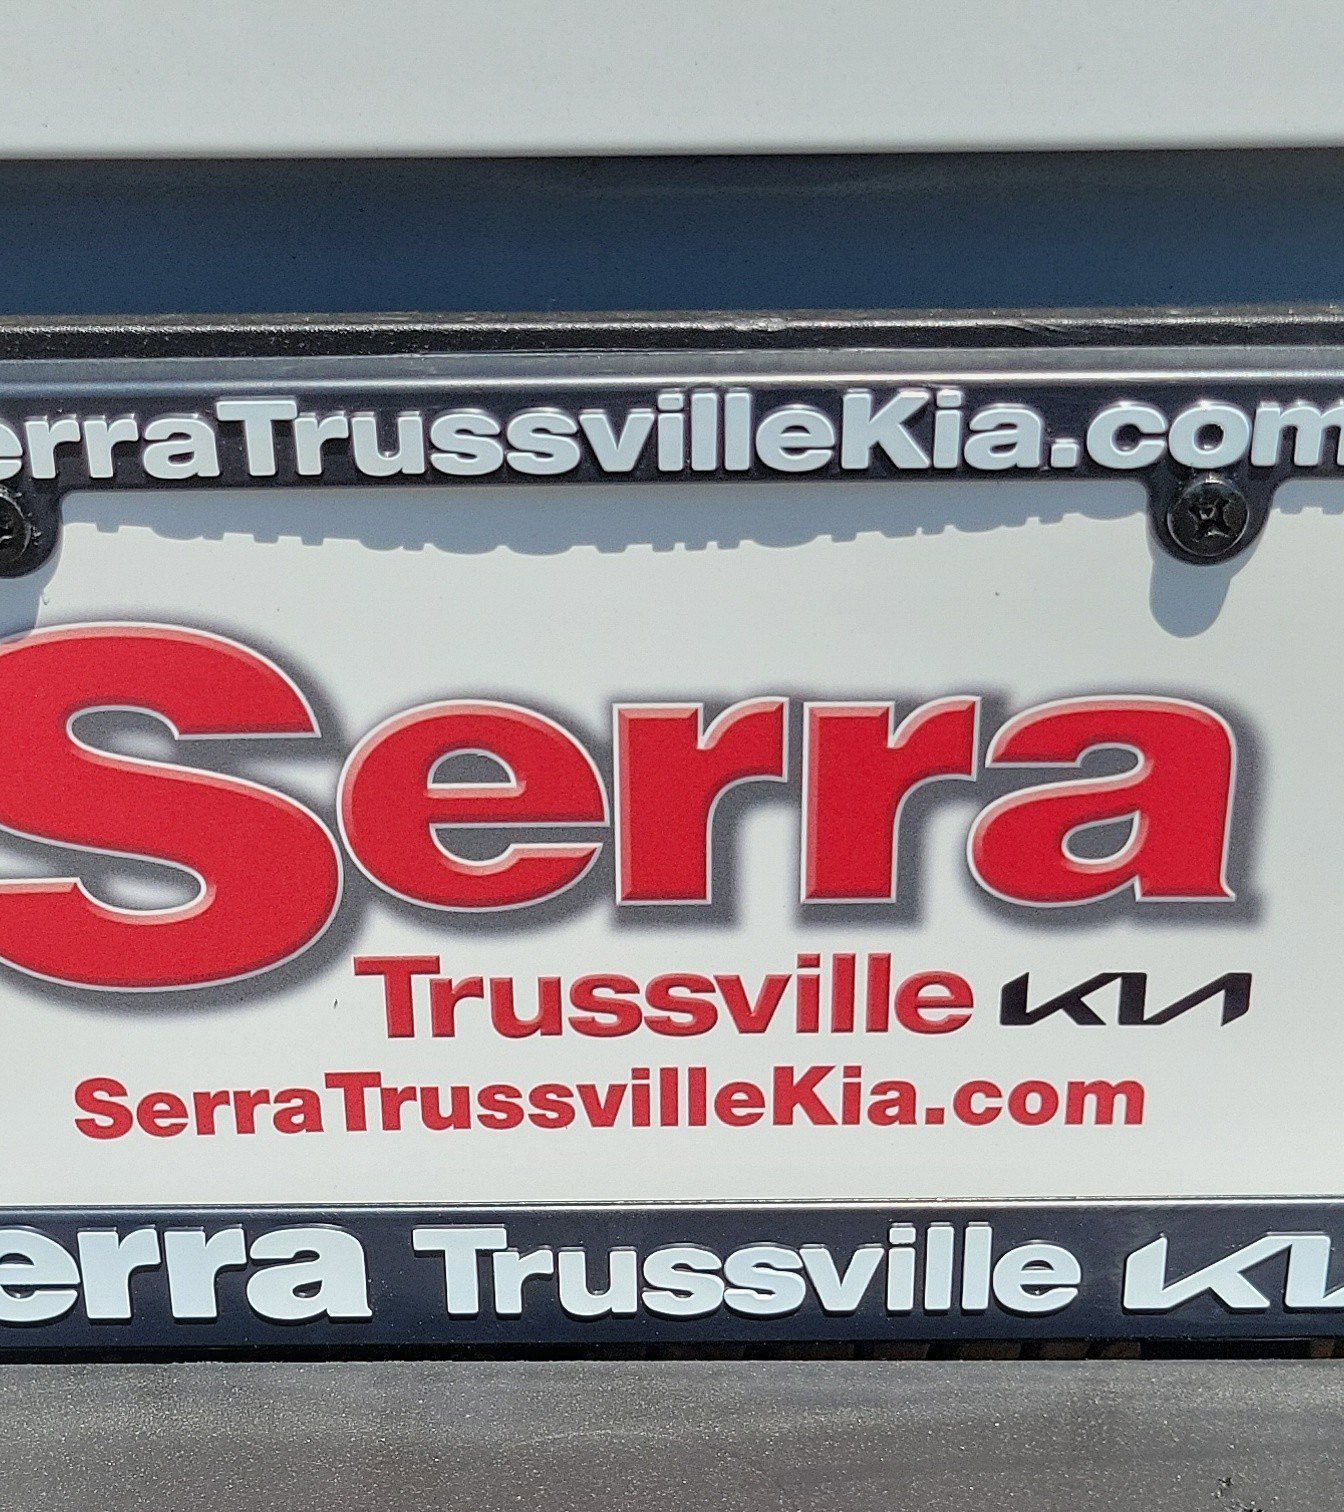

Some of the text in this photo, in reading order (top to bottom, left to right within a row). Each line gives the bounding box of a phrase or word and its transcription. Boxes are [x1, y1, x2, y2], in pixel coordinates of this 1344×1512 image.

[354, 953, 974, 1040] Trussville
[74, 1067, 1145, 1139] SerraTrussvilleKia.com
[413, 1223, 1080, 1318] Trussville
